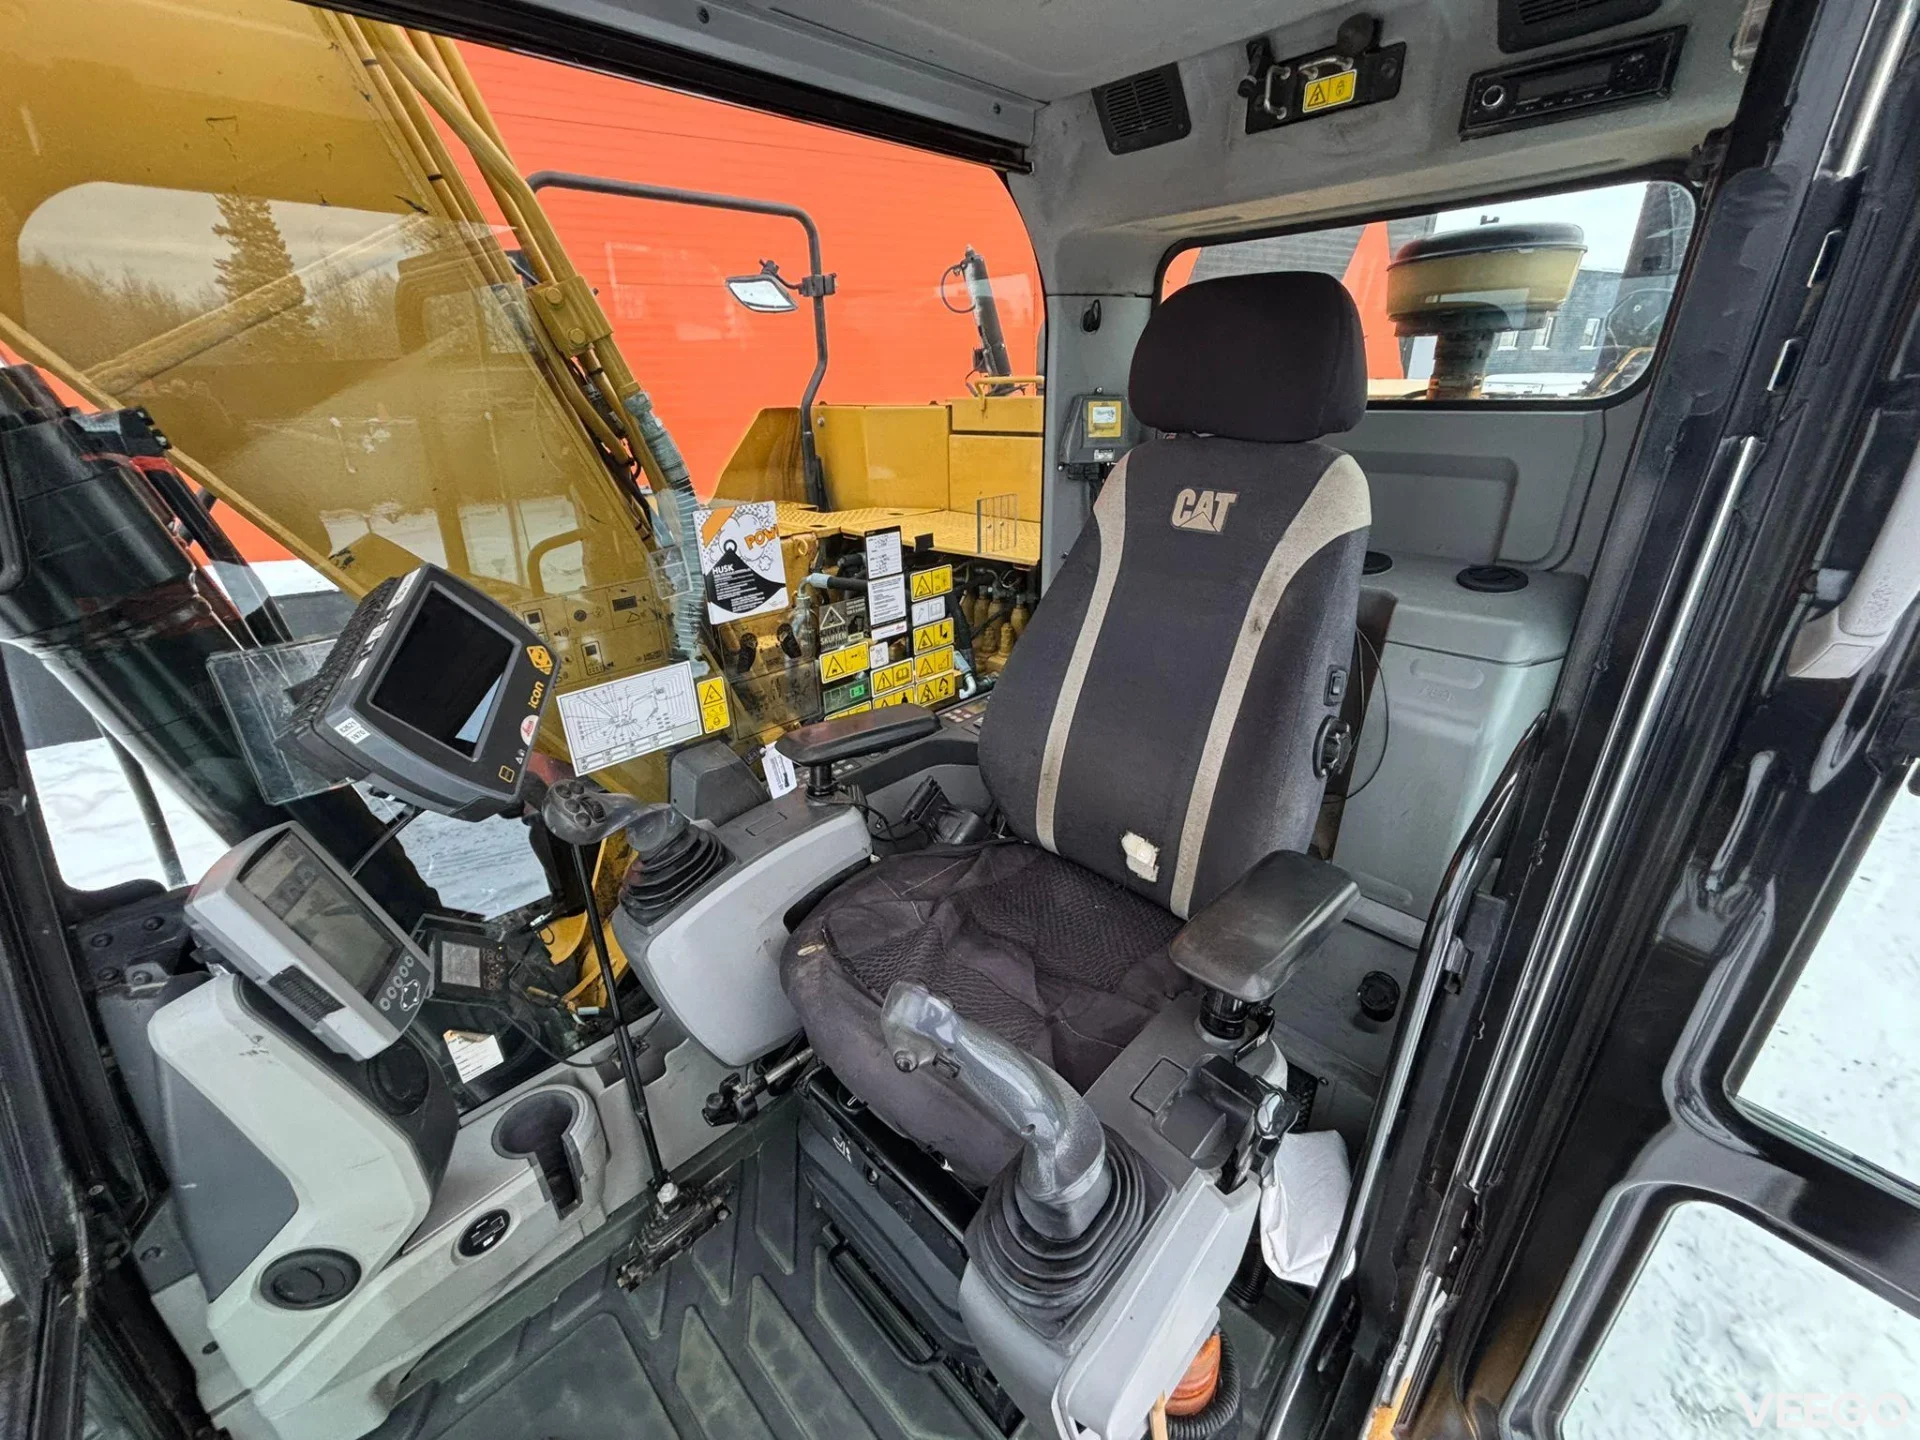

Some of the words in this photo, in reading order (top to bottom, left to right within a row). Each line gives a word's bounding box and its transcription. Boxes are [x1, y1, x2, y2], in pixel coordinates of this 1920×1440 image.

[1171, 488, 1238, 533] CAT
[712, 564, 735, 575] HUSK
[527, 680, 545, 709] icon
